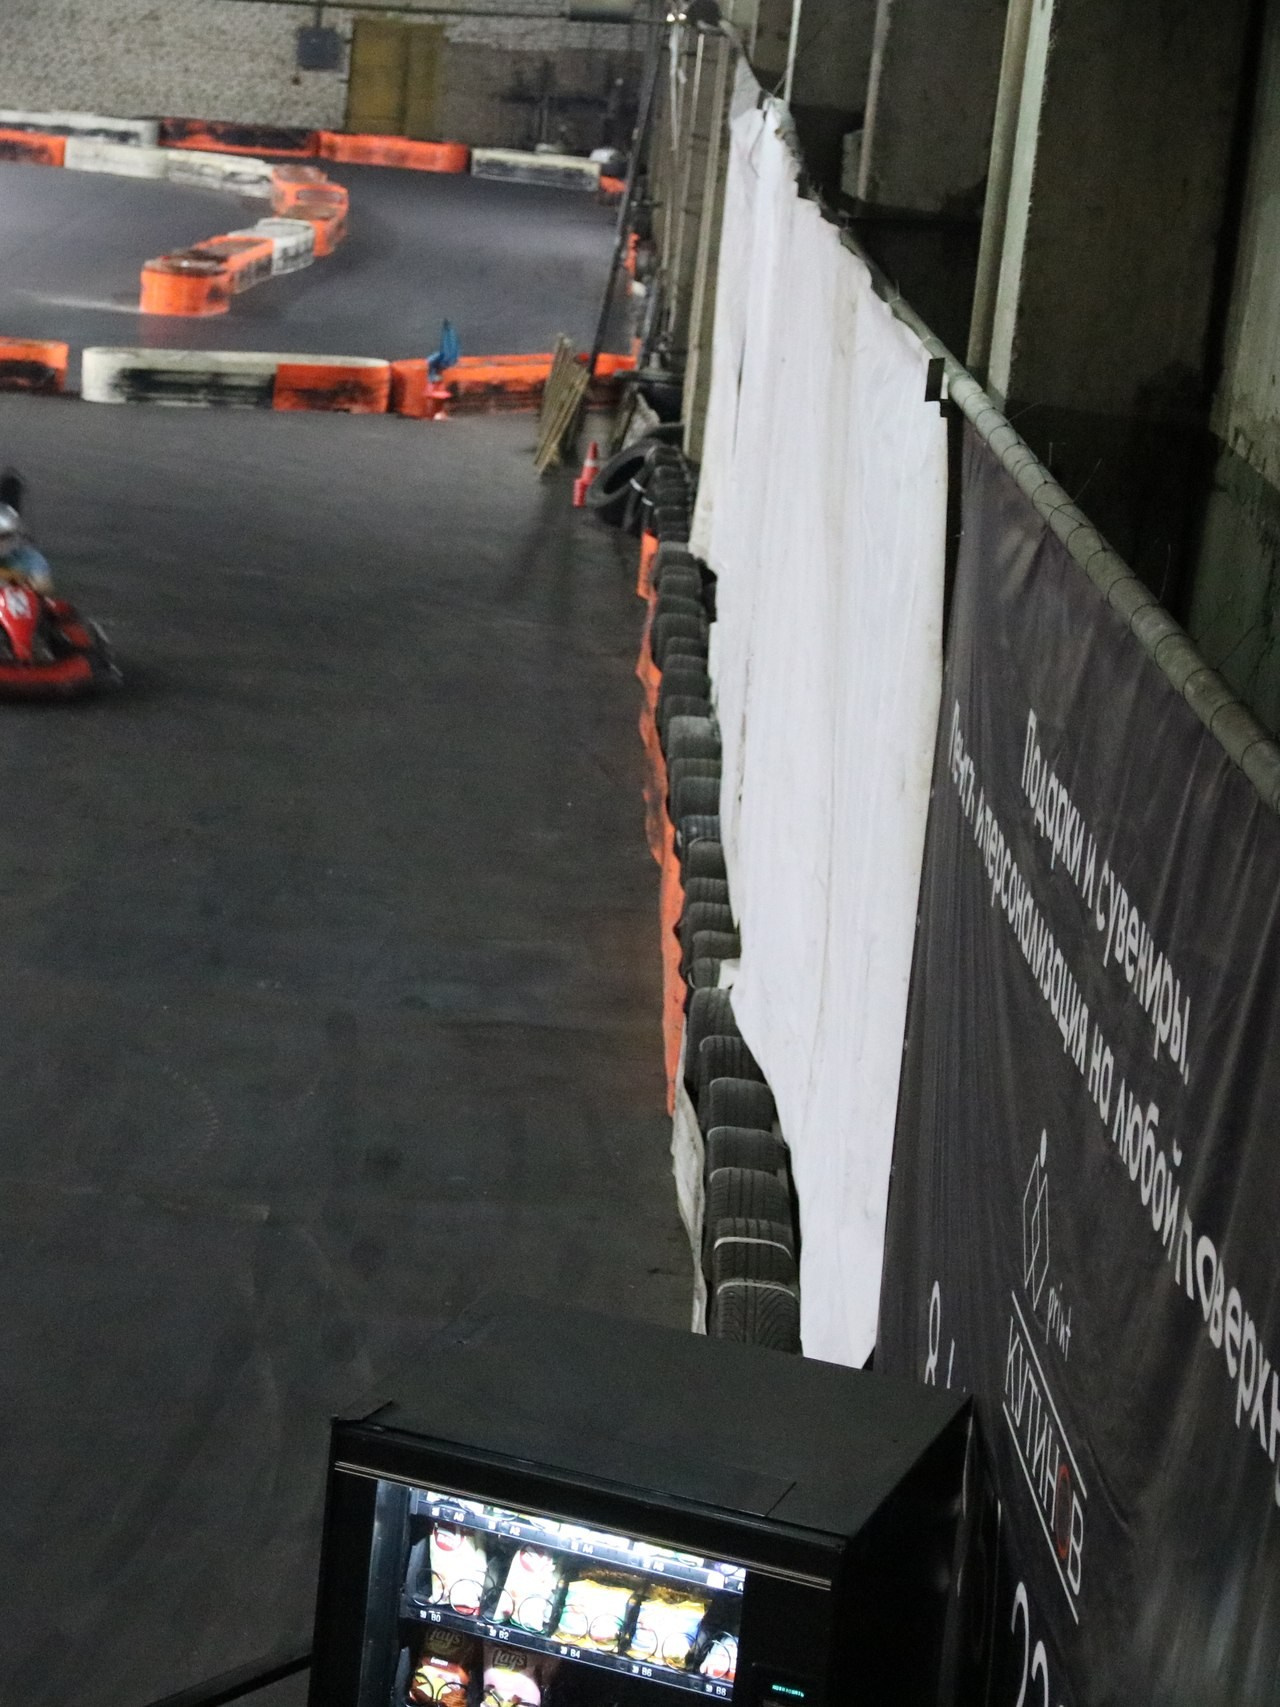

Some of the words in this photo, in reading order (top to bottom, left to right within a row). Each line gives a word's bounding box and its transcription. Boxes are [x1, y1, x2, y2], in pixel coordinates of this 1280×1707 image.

[1022, 708, 1084, 884] Подарки
[1073, 833, 1096, 908] и
[1096, 860, 1191, 1085] сувениры.
[983, 804, 1088, 1075] персонализация
[1088, 1023, 1114, 1125] на
[1112, 1078, 1182, 1261] любой
[499, 1631, 510, 1641] B2
[570, 1648, 581, 1659] B4
